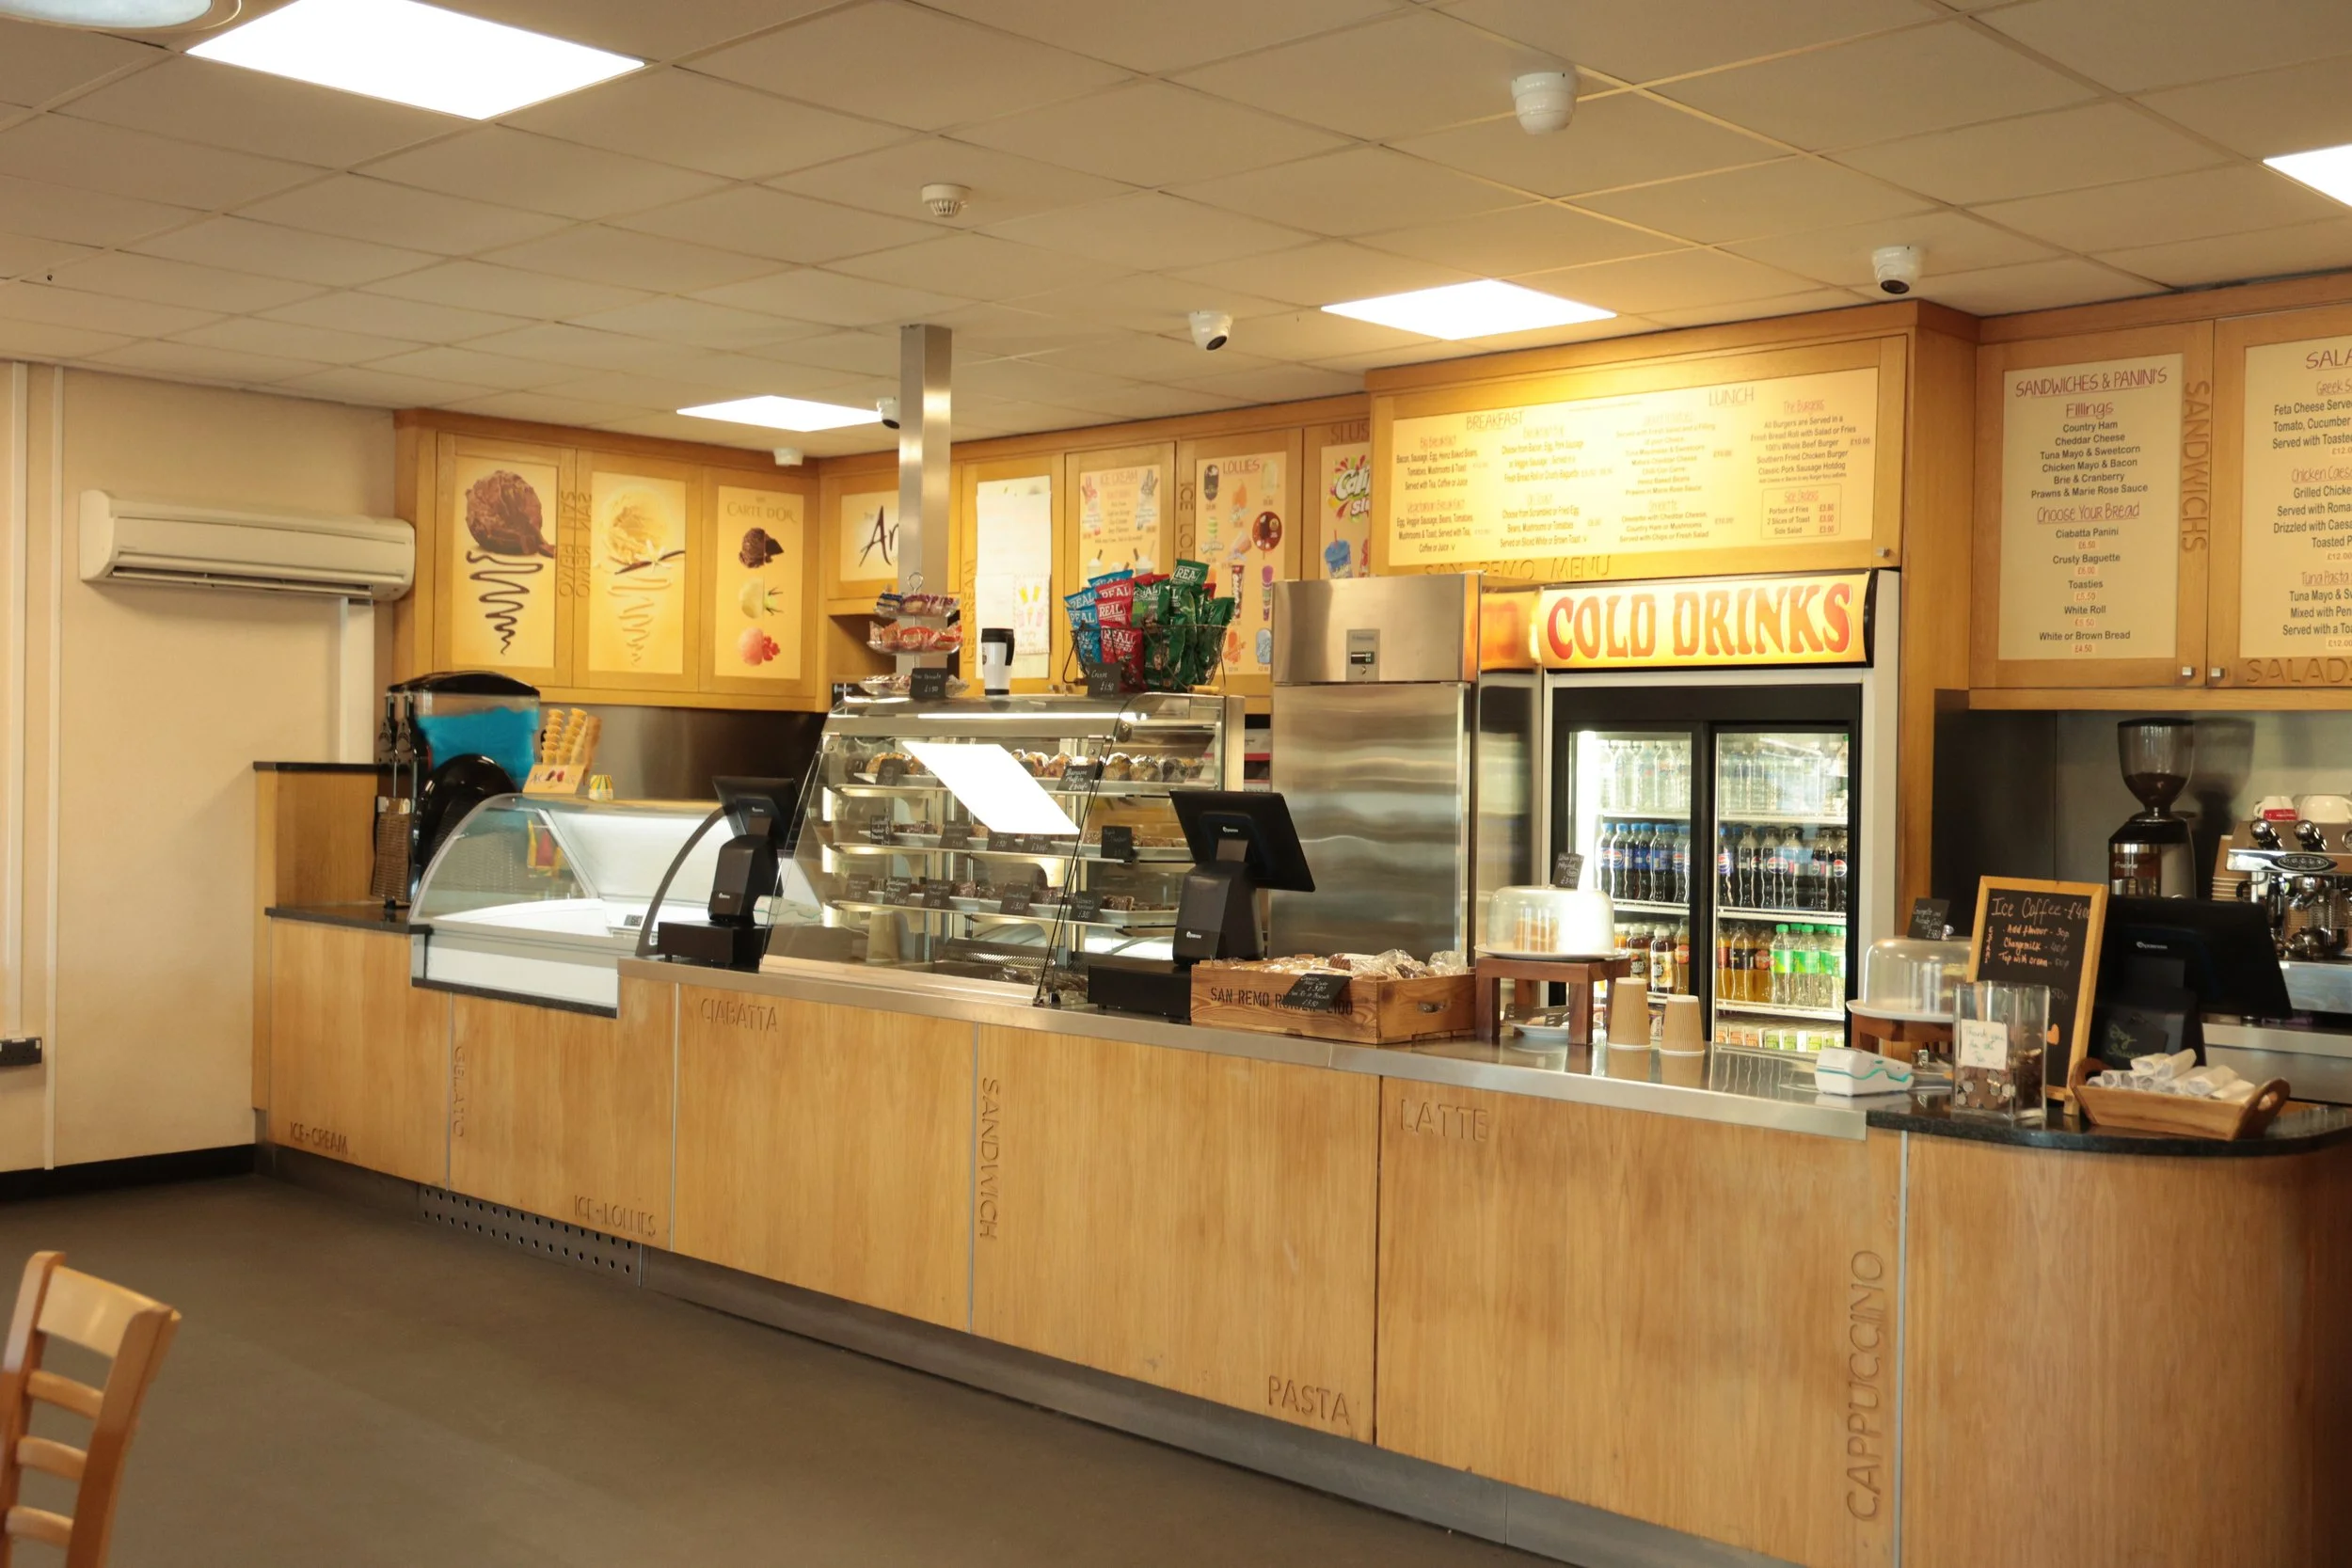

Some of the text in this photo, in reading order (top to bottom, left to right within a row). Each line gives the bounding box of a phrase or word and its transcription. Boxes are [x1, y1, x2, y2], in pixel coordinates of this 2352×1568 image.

[2015, 367, 2168, 398] SANDWICHES & PANINI'S
[1708, 387, 1755, 407] LUNCH
[2065, 402, 2114, 420] Fillings
[2273, 404, 2292, 415] Feta
[2293, 402, 2324, 413] Cheese
[1466, 411, 1523, 432] BREAKFAST
[2062, 421, 2117, 433] Country Ham
[2307, 415, 2352, 429] Cucumber
[2054, 434, 2125, 446] Cheddar Cheese
[2272, 437, 2301, 449] Served
[2302, 435, 2320, 446] with
[2039, 446, 2140, 460] Tuna Mayo & Sweetcorn
[1223, 459, 1260, 475] LOLLIES
[2041, 459, 2137, 472] Chicken Mayo & Bacon
[2053, 473, 2124, 484] Brie & Cranberry
[2031, 484, 2148, 498] Prawns & Marie Rose Sauce
[2293, 487, 2321, 498] Grilled
[2277, 504, 2306, 516] Served
[2307, 503, 2325, 514] with
[2055, 527, 2118, 538] Ciabatta Panini
[2273, 521, 2306, 533] Drizzled
[2308, 520, 2325, 531] with
[2311, 536, 2344, 548] Toasted
[2052, 553, 2120, 565] Crusty Baguette
[1550, 554, 1612, 579] MENU
[2068, 579, 2104, 589] Toasties
[2289, 588, 2341, 603] Tuna Mayo &
[1099, 603, 1123, 617] REAL
[2064, 605, 2106, 614] White Roll
[2290, 607, 2314, 618] Mixed
[2316, 606, 2333, 617] with
[1547, 583, 1852, 660] COLD DRINKS
[2039, 632, 2062, 640] White
[2075, 631, 2102, 640] Brown
[2104, 630, 2130, 639] Bread
[2282, 624, 2311, 635] Served
[2312, 623, 2331, 634] with
[2247, 658, 2352, 684] SALAD
[1991, 896, 2062, 927] Ice Coffee
[1210, 985, 1234, 1006] SAN
[1237, 989, 1270, 1007] REMO
[701, 997, 779, 1033] CIABATTA
[1400, 1098, 1488, 1143] LATTE
[979, 1076, 1000, 1240] SANDWICH
[1846, 1249, 1884, 1522] CAPPUCCINO
[1267, 1374, 1350, 1426] PASTA
